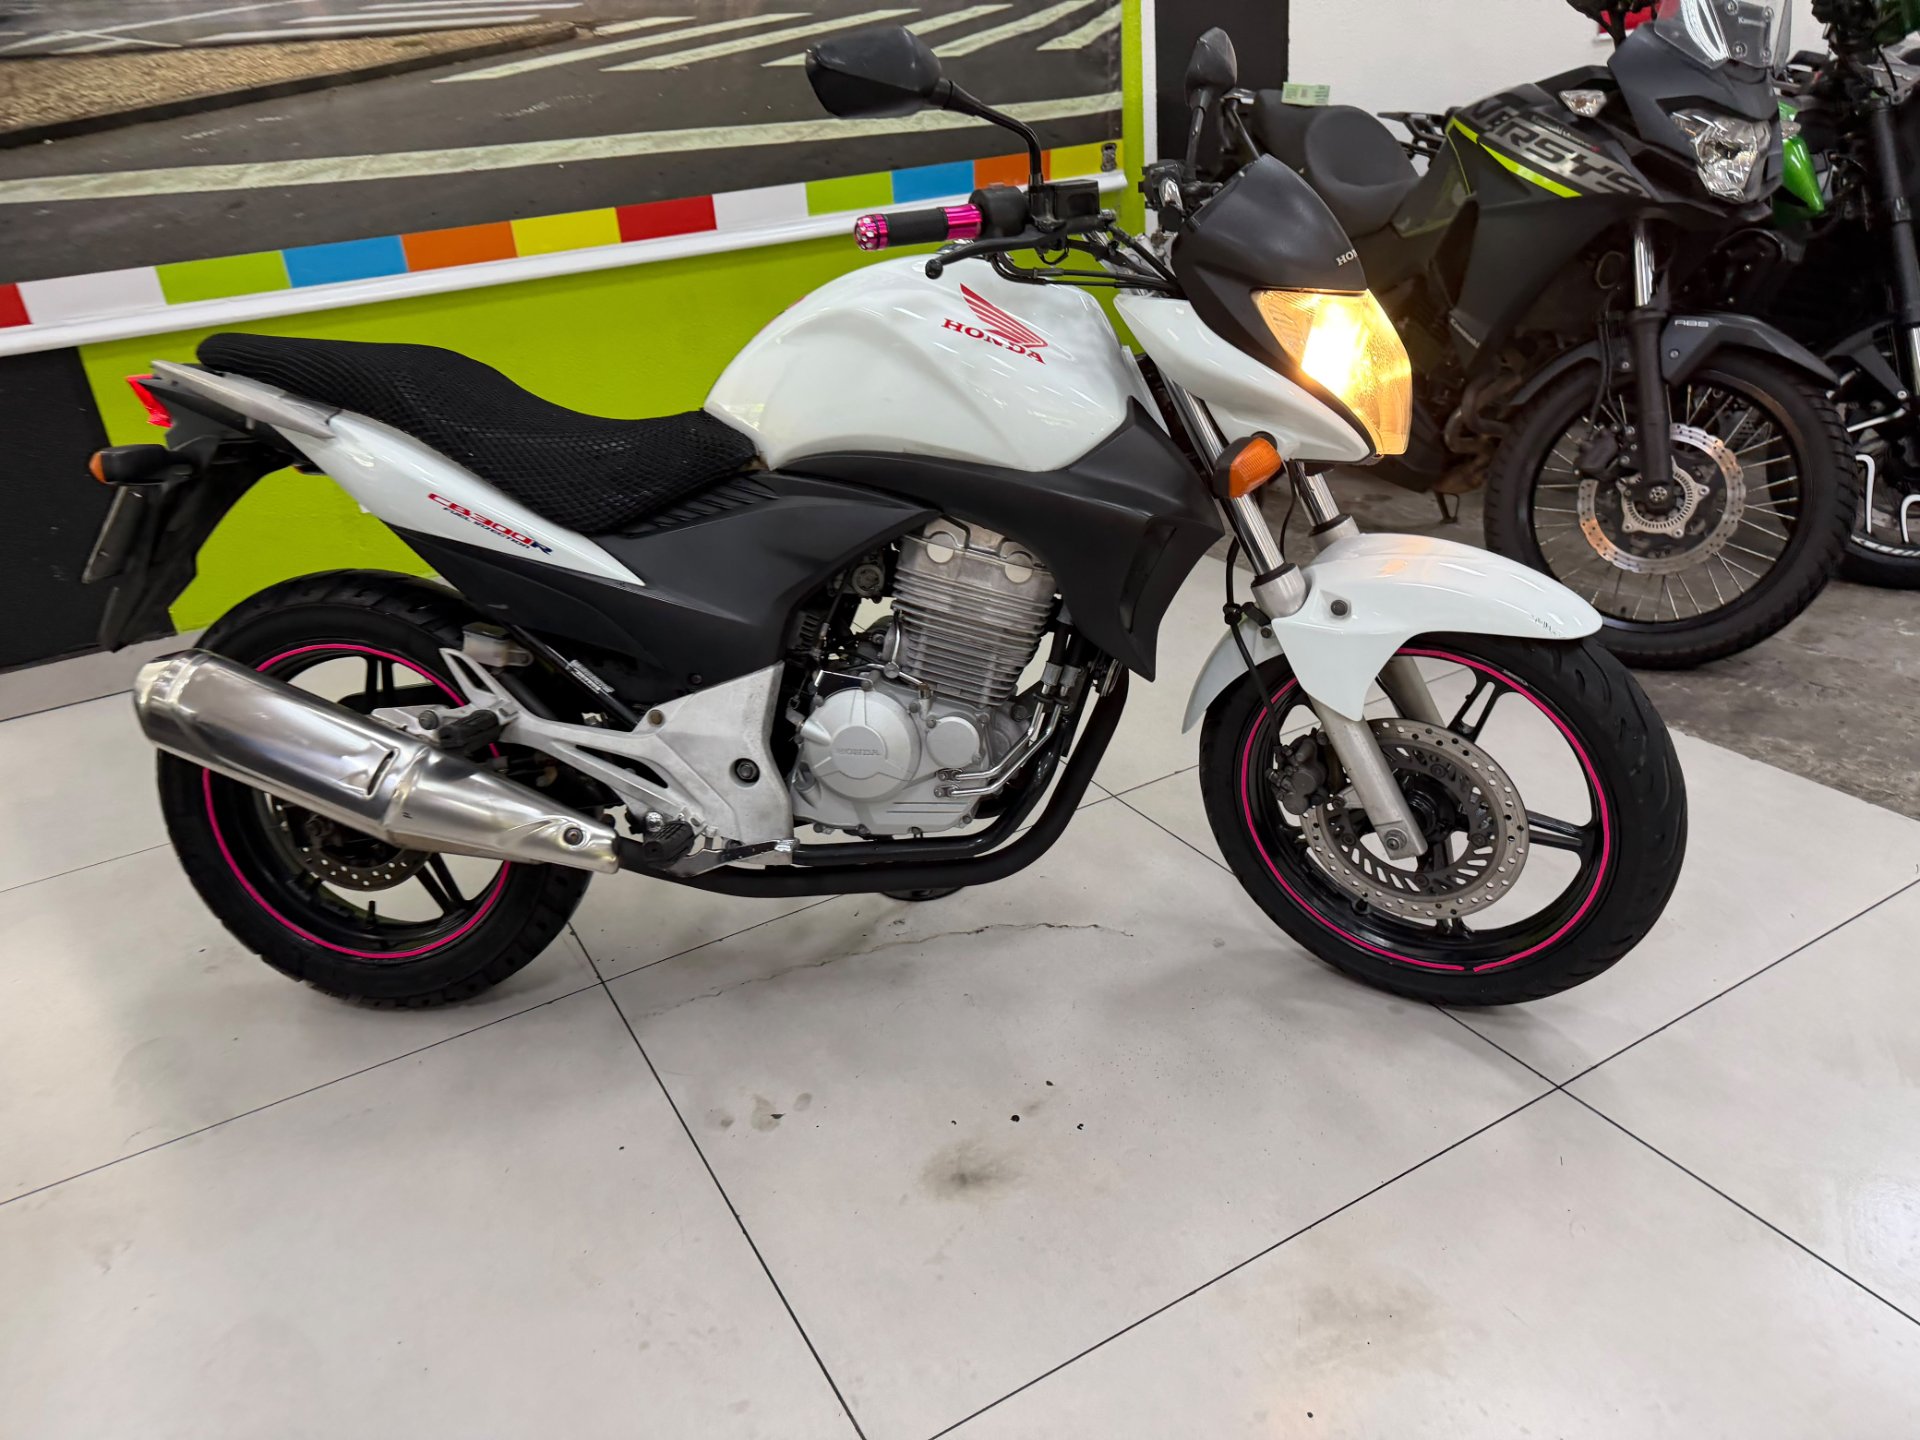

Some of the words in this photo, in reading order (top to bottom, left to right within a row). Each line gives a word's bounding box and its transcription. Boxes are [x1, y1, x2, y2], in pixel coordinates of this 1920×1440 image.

[941, 317, 1047, 365] HONDA
[427, 493, 553, 555] CB300R
[442, 507, 473, 522] FUEL
[473, 520, 531, 549] INJECTION
